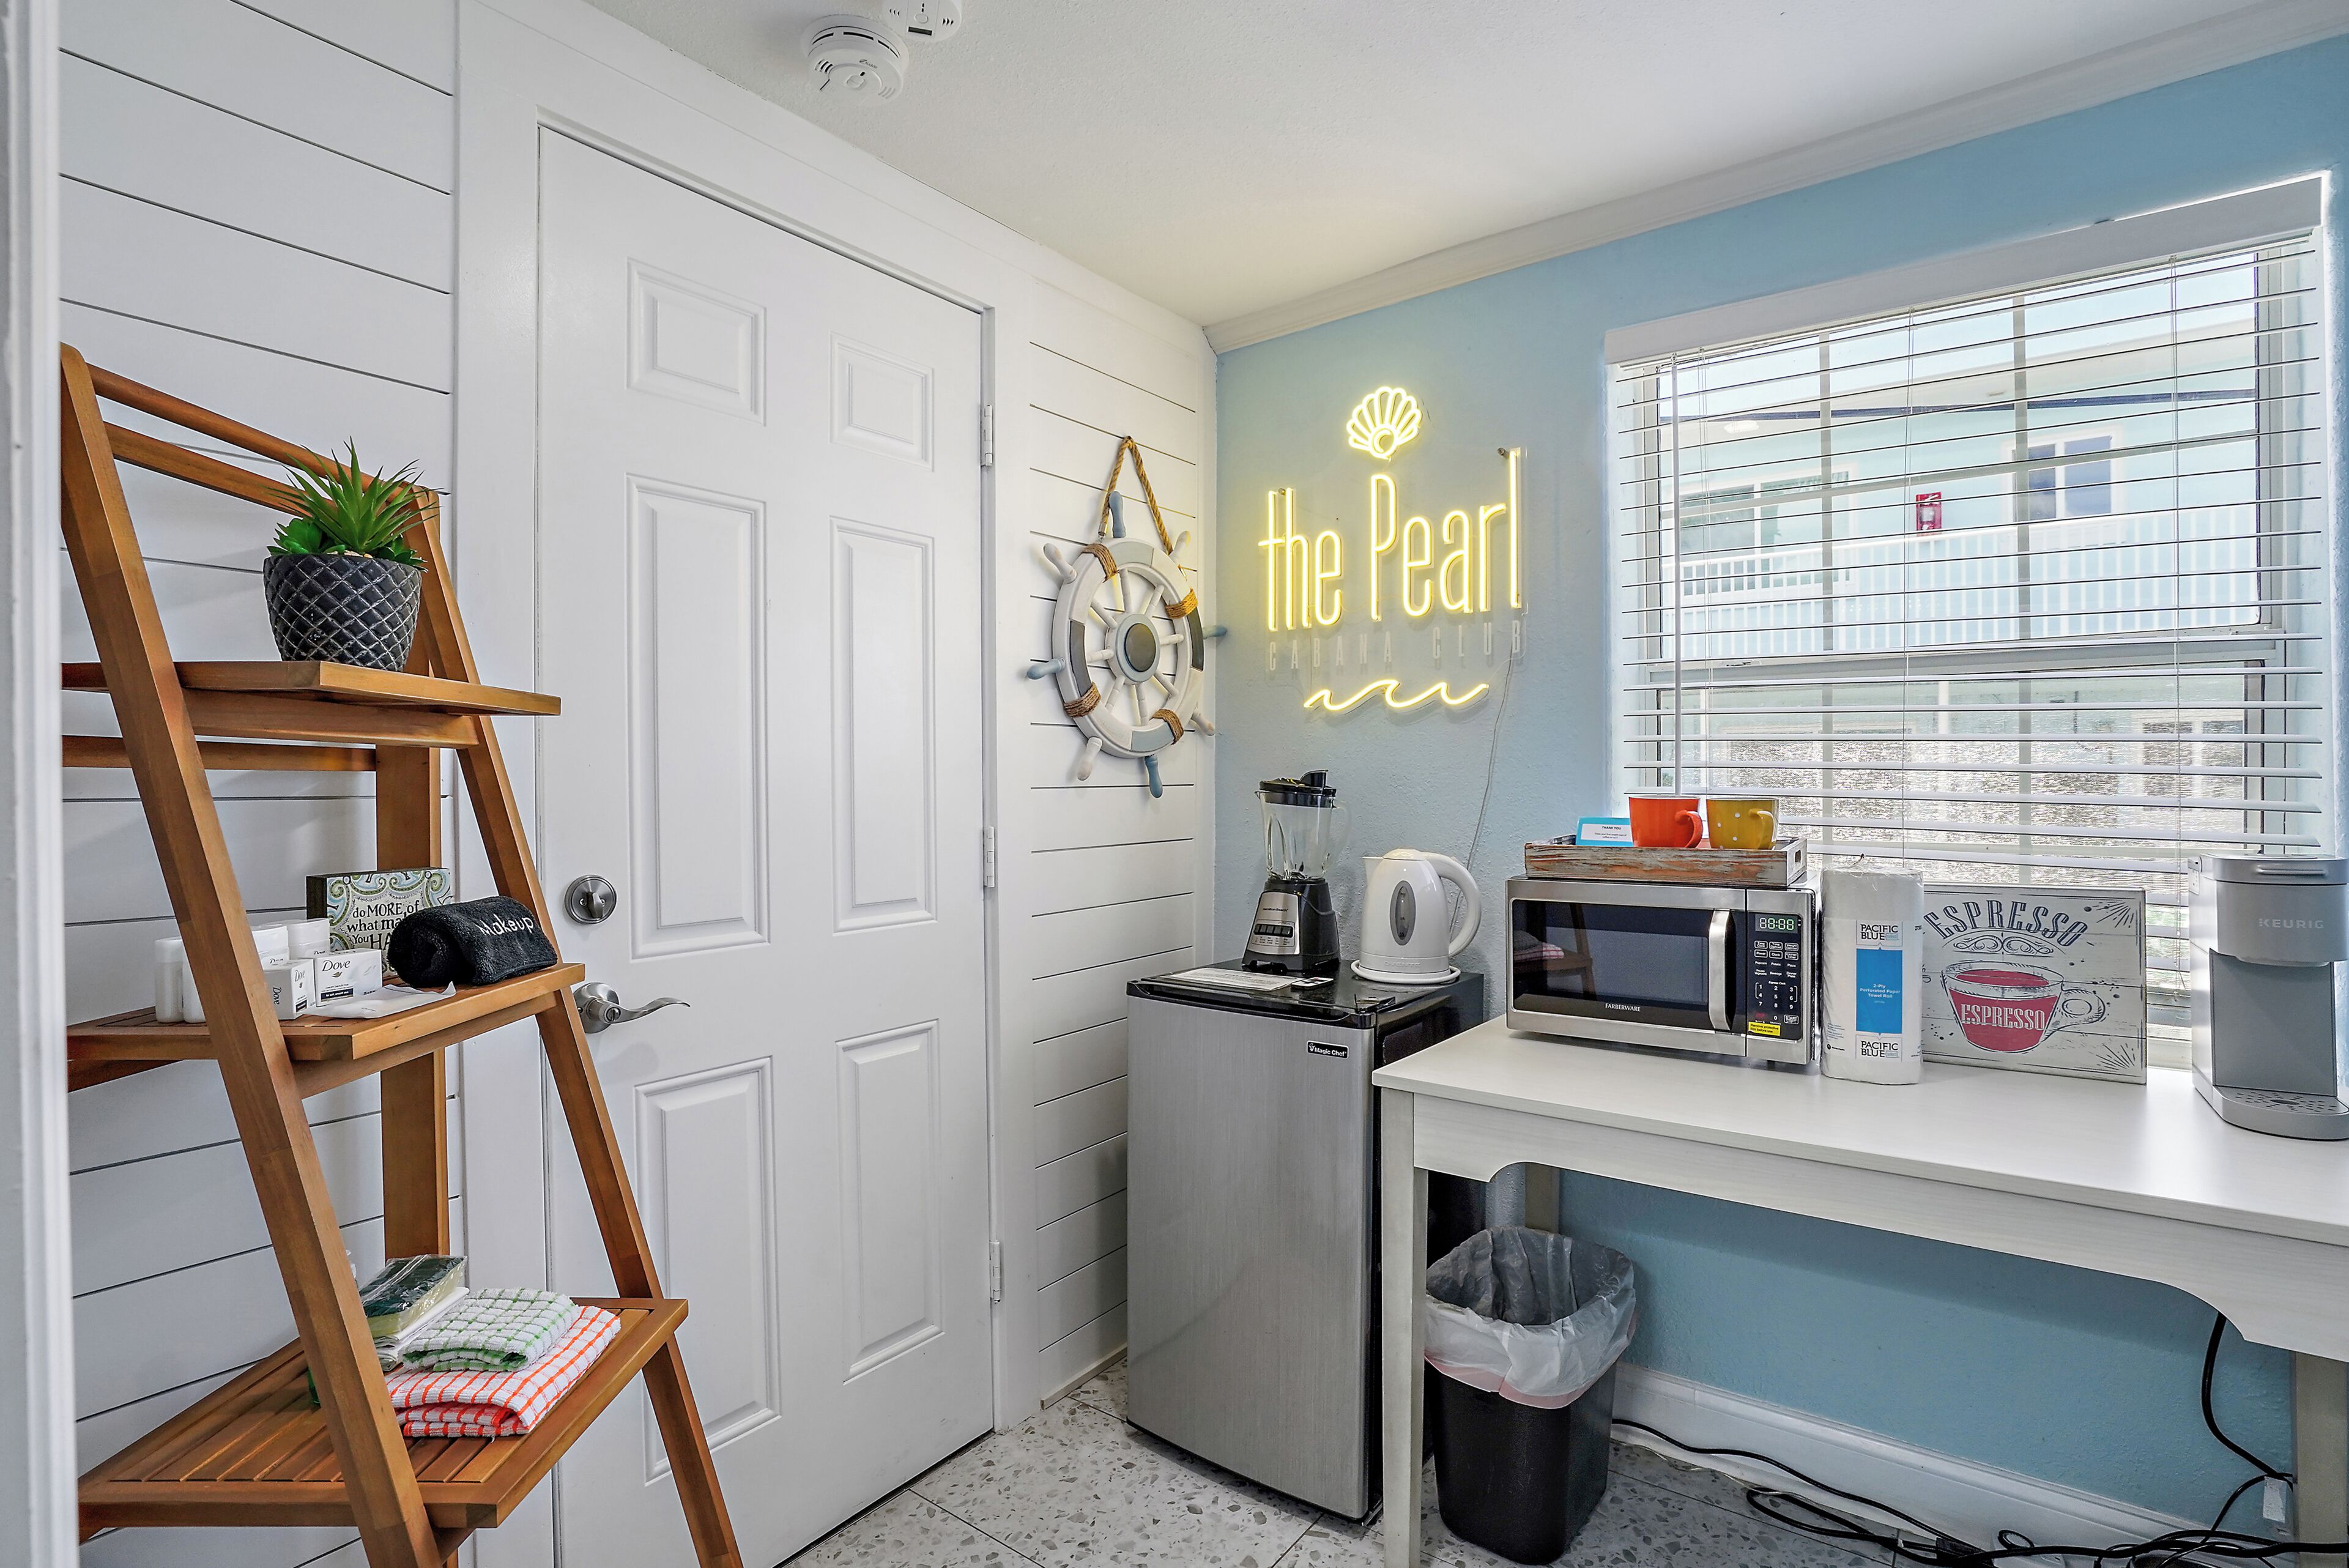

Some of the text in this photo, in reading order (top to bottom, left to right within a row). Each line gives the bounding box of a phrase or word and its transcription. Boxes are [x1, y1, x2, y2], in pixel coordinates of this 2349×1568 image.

[1258, 447, 1521, 631] the Pearl
[1269, 620, 1521, 671] CABANA CLUB
[353, 900, 420, 918] do MORE of
[347, 919, 378, 932] what
[473, 913, 534, 935] Makeup
[1860, 924, 1898, 933] PACIFIC
[1923, 900, 2088, 948] ESPRESSO
[2258, 918, 2325, 929] KEURIG
[352, 934, 369, 944] You
[1860, 932, 1885, 940] BLUE
[322, 960, 351, 972] Dove
[295, 970, 305, 982] Dove
[273, 987, 282, 1005] Dove
[1605, 1003, 1641, 1012] FARBERWARE
[1961, 1003, 2047, 1031] ESPRESSO
[1861, 1041, 1898, 1050] PACIFIC
[1861, 1048, 1885, 1057] BLUE
